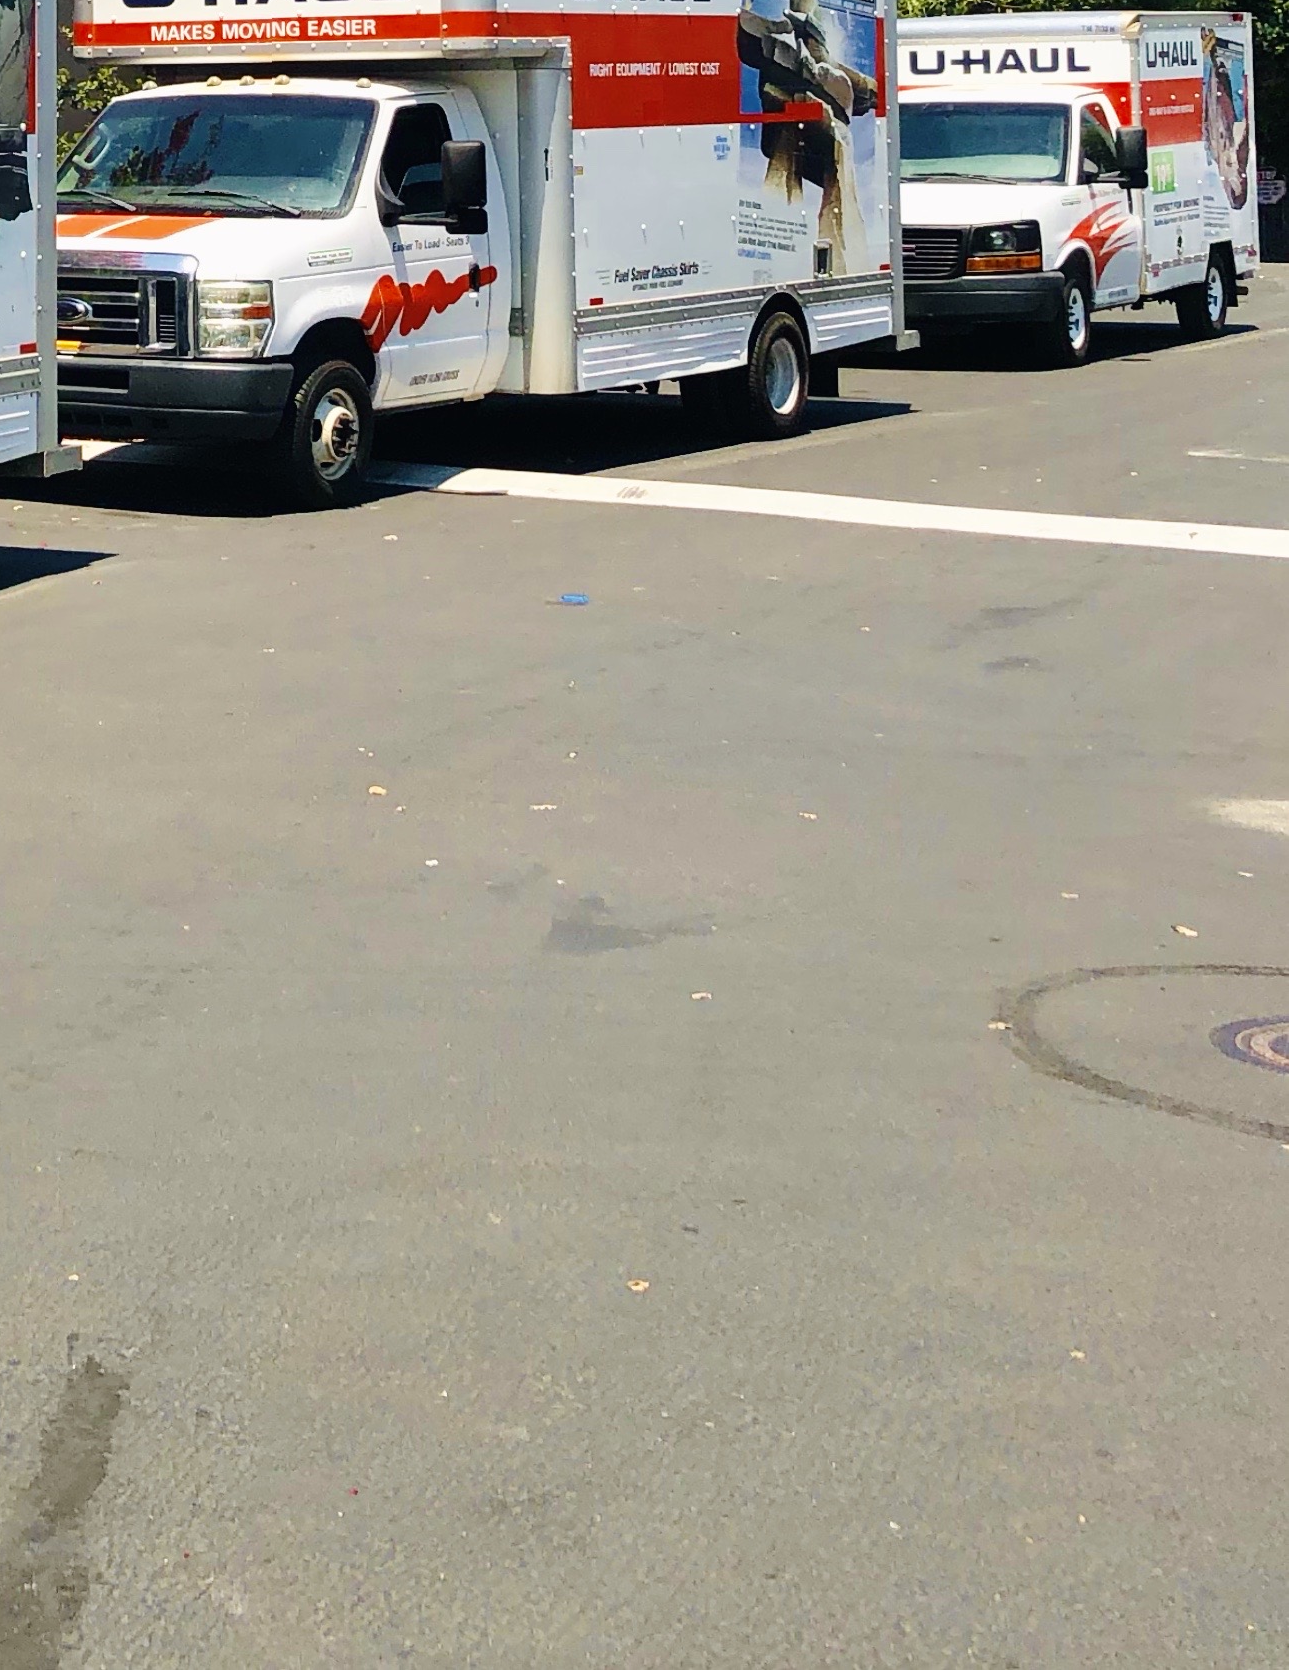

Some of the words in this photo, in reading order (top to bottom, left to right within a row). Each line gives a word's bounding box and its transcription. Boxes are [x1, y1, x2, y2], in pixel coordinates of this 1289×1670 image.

[150, 24, 215, 41] MAKES
[222, 20, 300, 40] MOVING
[307, 19, 376, 37] EASIER
[589, 62, 614, 77] RIGHT
[616, 62, 661, 77] EQUIPMENT
[668, 62, 698, 76] LOWEST
[700, 62, 720, 75] COST
[424, 237, 441, 249] Load
